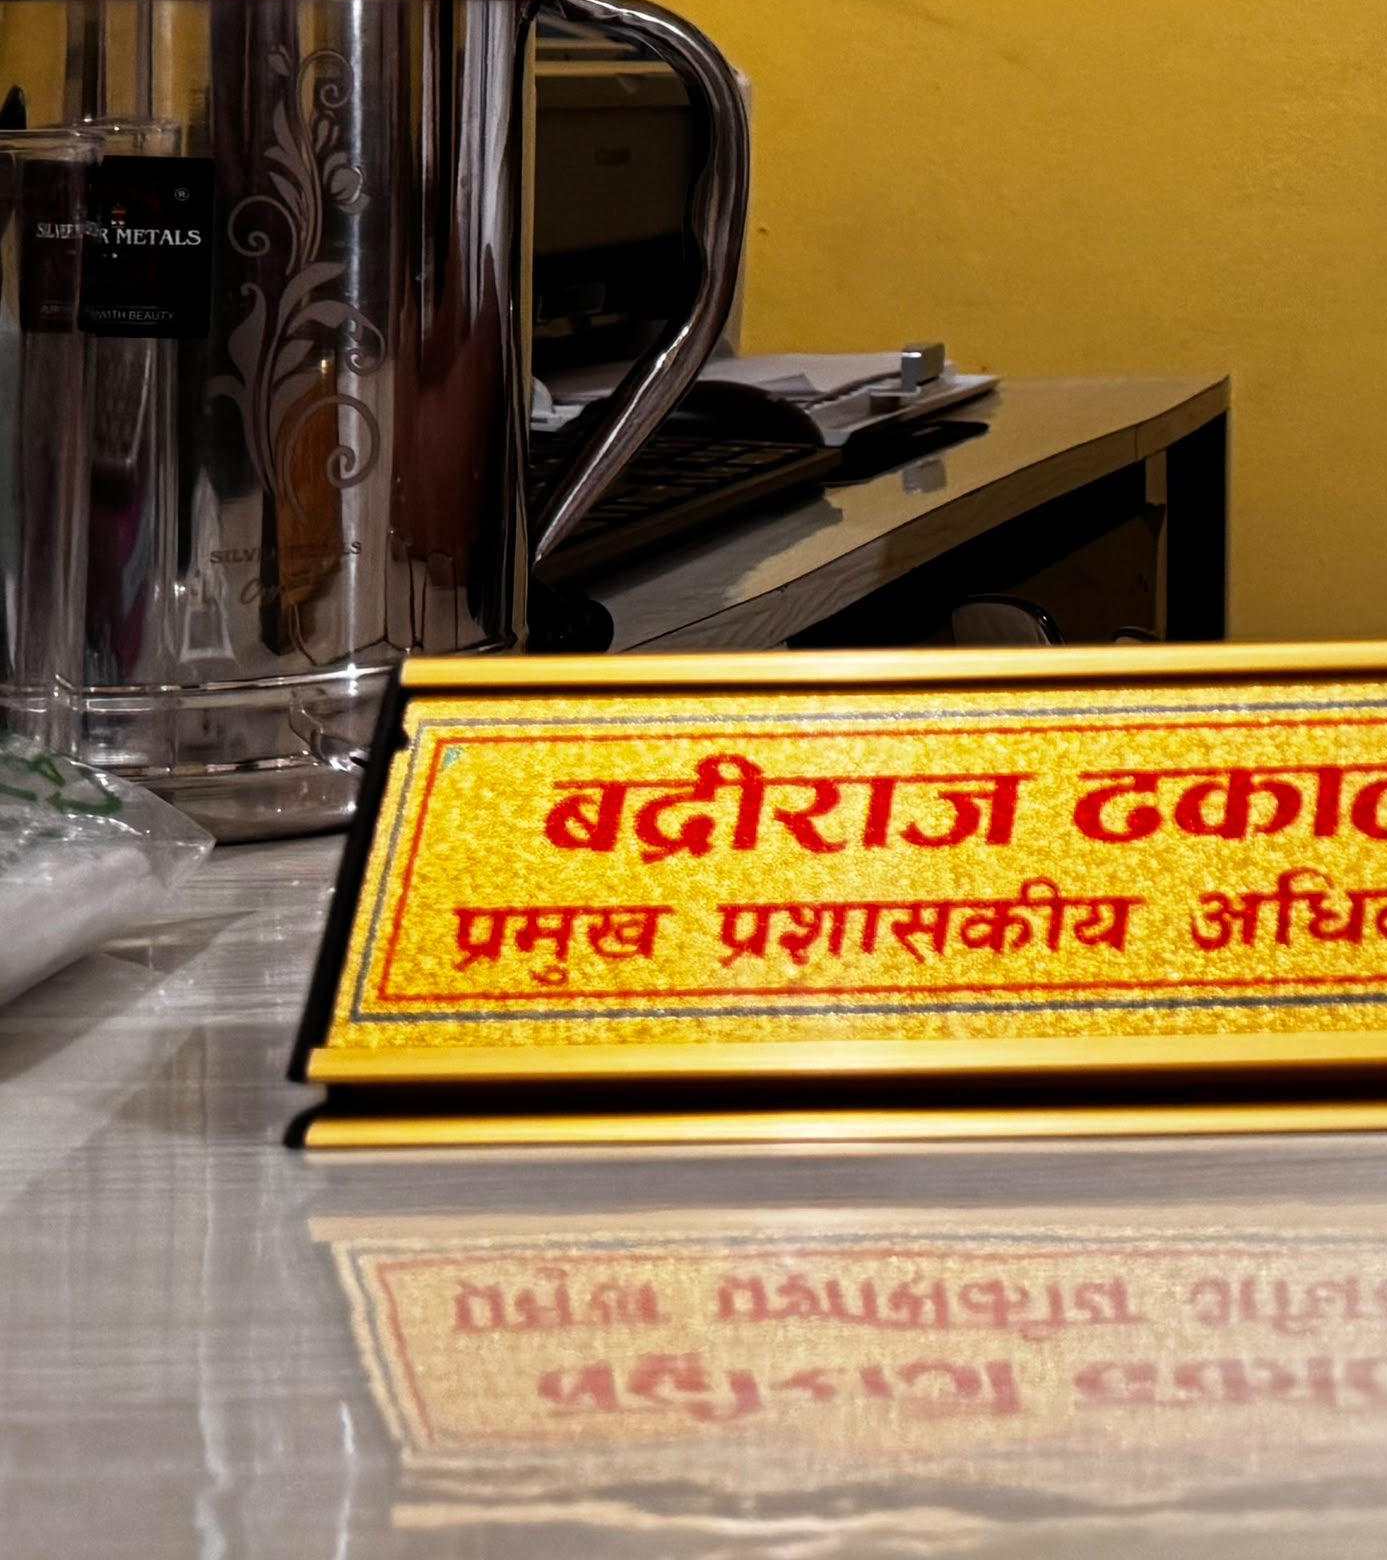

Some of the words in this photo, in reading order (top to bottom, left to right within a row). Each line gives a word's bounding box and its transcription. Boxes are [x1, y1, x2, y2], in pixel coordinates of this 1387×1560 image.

[116, 228, 202, 245] METALS
[128, 310, 175, 321] BEAUTY
[543, 752, 1038, 865] बद्रीराज
[453, 905, 675, 987] प्रमुख
[717, 877, 1146, 967] प्रशासकीय
